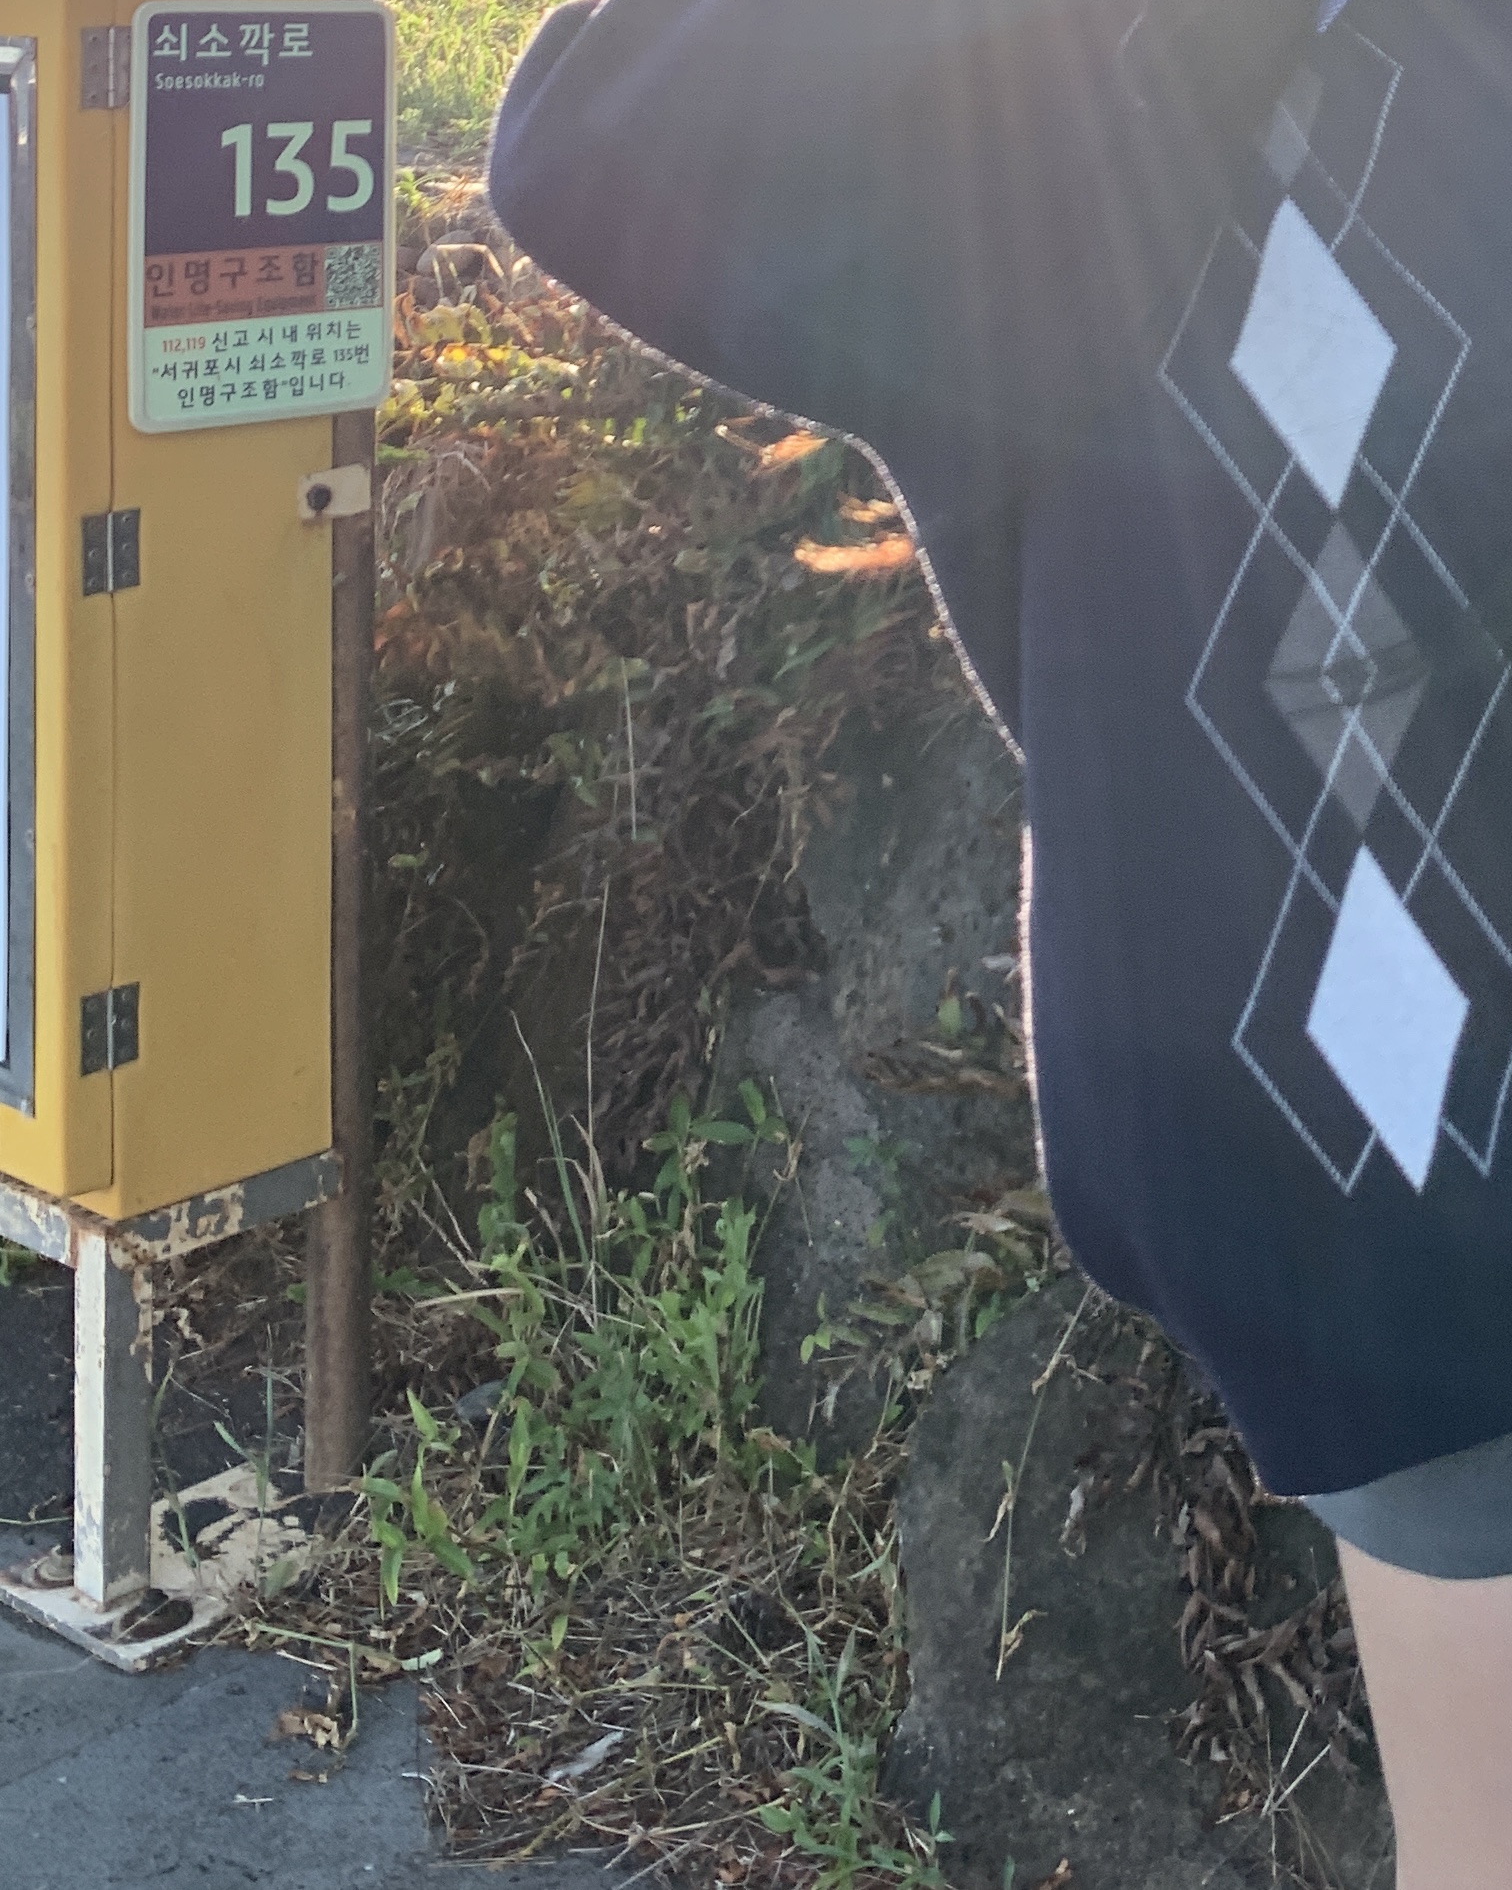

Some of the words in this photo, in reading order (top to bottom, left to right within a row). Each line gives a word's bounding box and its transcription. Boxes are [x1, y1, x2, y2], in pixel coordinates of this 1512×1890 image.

[153, 22, 313, 66] 쇠소깍로
[155, 71, 265, 90] Soesokkak-ro
[220, 118, 374, 218] 135
[146, 252, 319, 298] 인명구조함
[162, 336, 206, 354] 112,119
[212, 329, 249, 353] 신고
[257, 326, 273, 346] 시
[282, 324, 298, 343] 내
[306, 320, 362, 341] 위치는
[249, 347, 326, 373] 쇠소깍로
[333, 343, 370, 364] 135번
